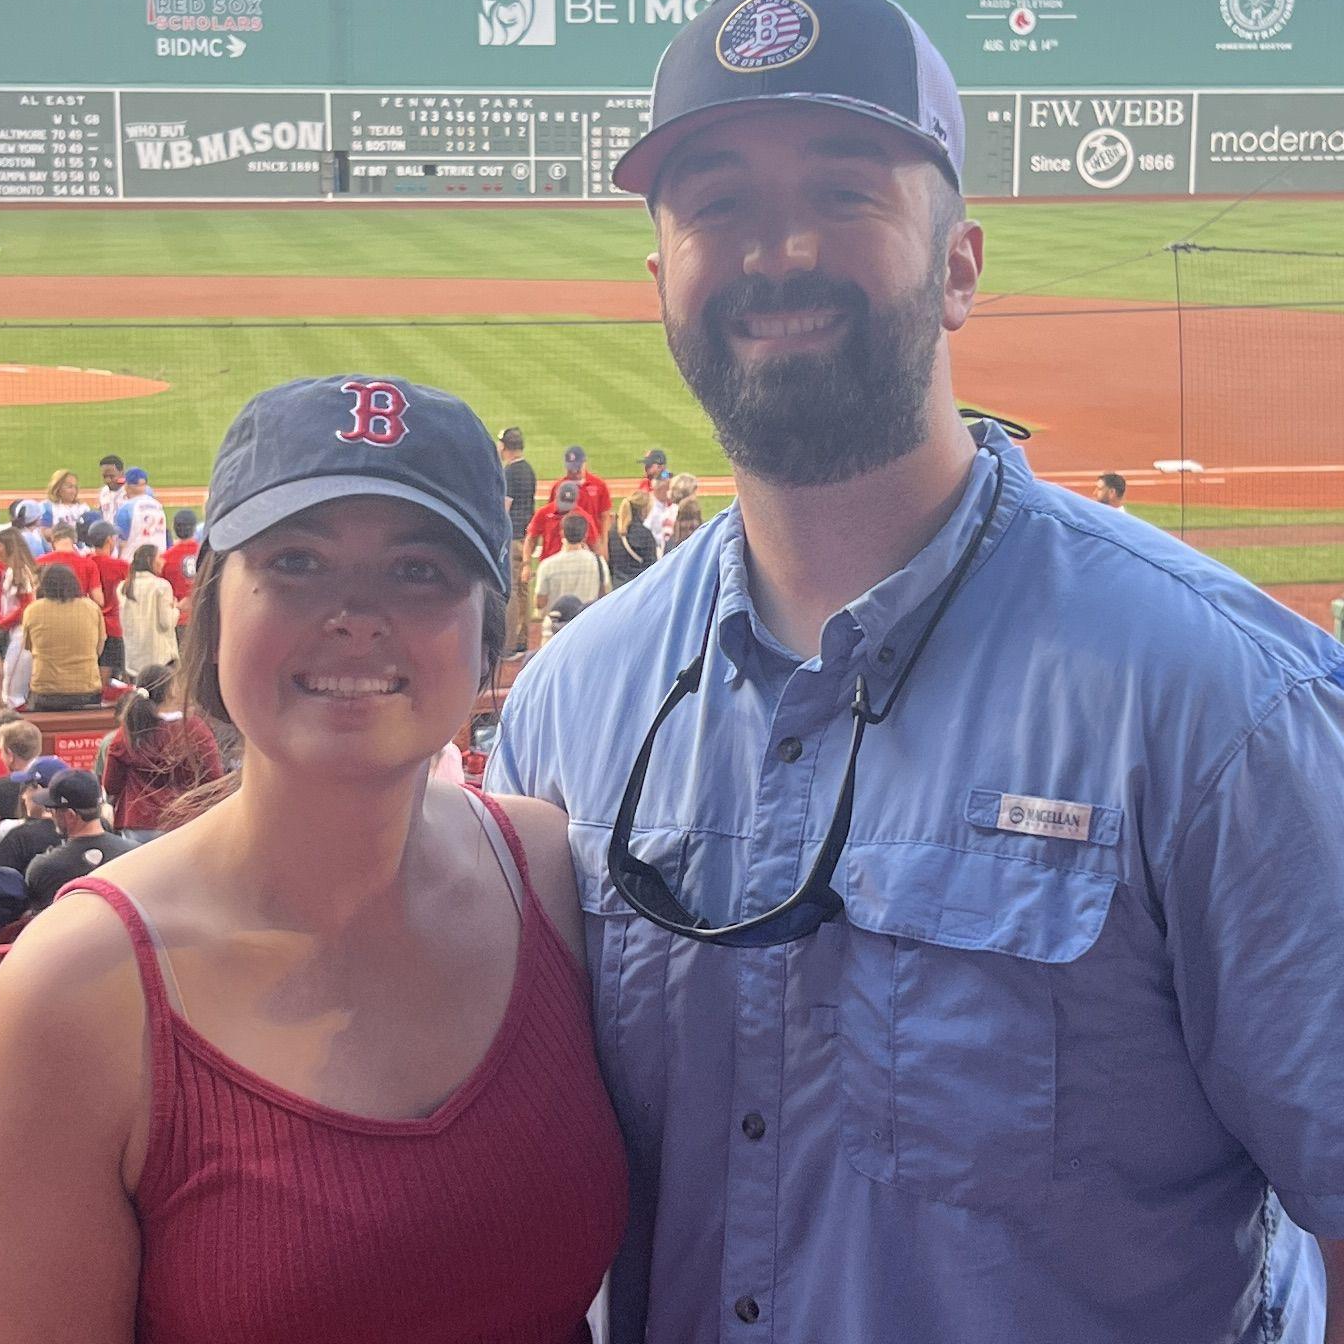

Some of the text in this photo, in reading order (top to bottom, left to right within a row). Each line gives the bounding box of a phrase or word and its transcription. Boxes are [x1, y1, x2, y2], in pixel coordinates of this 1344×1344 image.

[155, 16, 264, 31] SCHOLARS
[156, 38, 224, 57] BIDMC
[19, 95, 86, 106] AL EAST
[380, 97, 534, 108] FENWAY PARK
[606, 99, 651, 109] AMERI
[351, 111, 362, 122] P
[1090, 99, 1185, 127] WEBB
[70, 114, 79, 125] L
[83, 114, 101, 125] GB
[51, 129, 66, 140] 70
[125, 123, 186, 138] WHO BUT
[367, 125, 404, 137] TEXAS
[17, 142, 46, 154] YORK
[51, 142, 67, 154] 70
[365, 140, 406, 152] BOSTON
[89, 157, 97, 168] 7
[248, 161, 320, 172] SINCE 1898
[1031, 155, 1072, 173] Since
[1138, 155, 1175, 172] 1866
[28, 170, 48, 182] BAY
[88, 170, 101, 182] 10
[396, 165, 425, 177] BALL
[435, 165, 475, 177] STRIKE
[478, 165, 504, 177] OUT
[335, 381, 410, 447] B
[58, 738, 102, 749] CAUTIO
[1027, 808, 1081, 827] MAGELLAN
